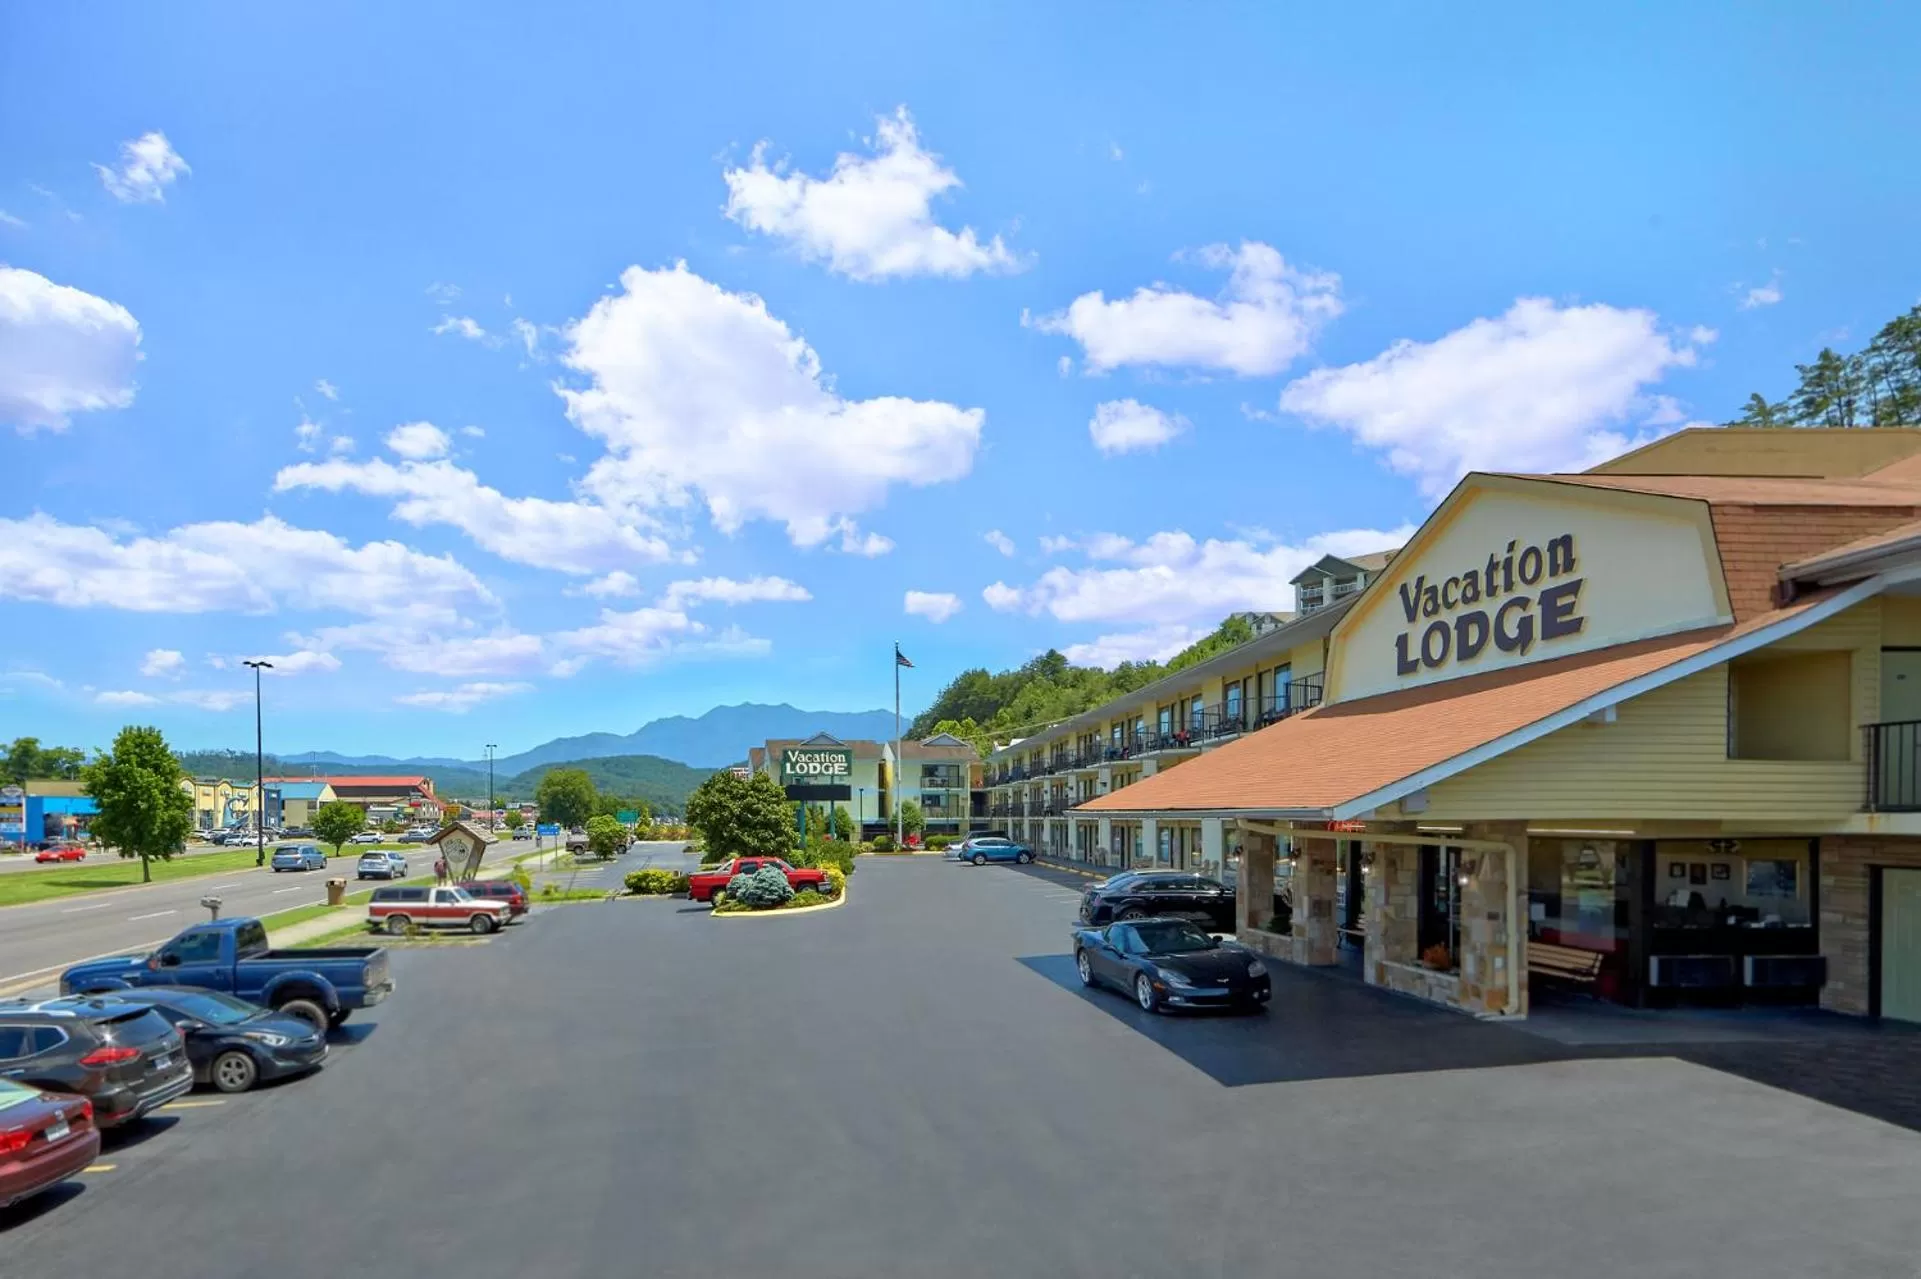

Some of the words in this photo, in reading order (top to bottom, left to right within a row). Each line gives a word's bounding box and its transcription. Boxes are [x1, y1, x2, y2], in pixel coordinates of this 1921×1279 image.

[1398, 533, 1577, 623] Vacation
[1395, 578, 1584, 676] LODGE
[785, 762, 849, 775] LODGE
[787, 750, 846, 763] Vacation
